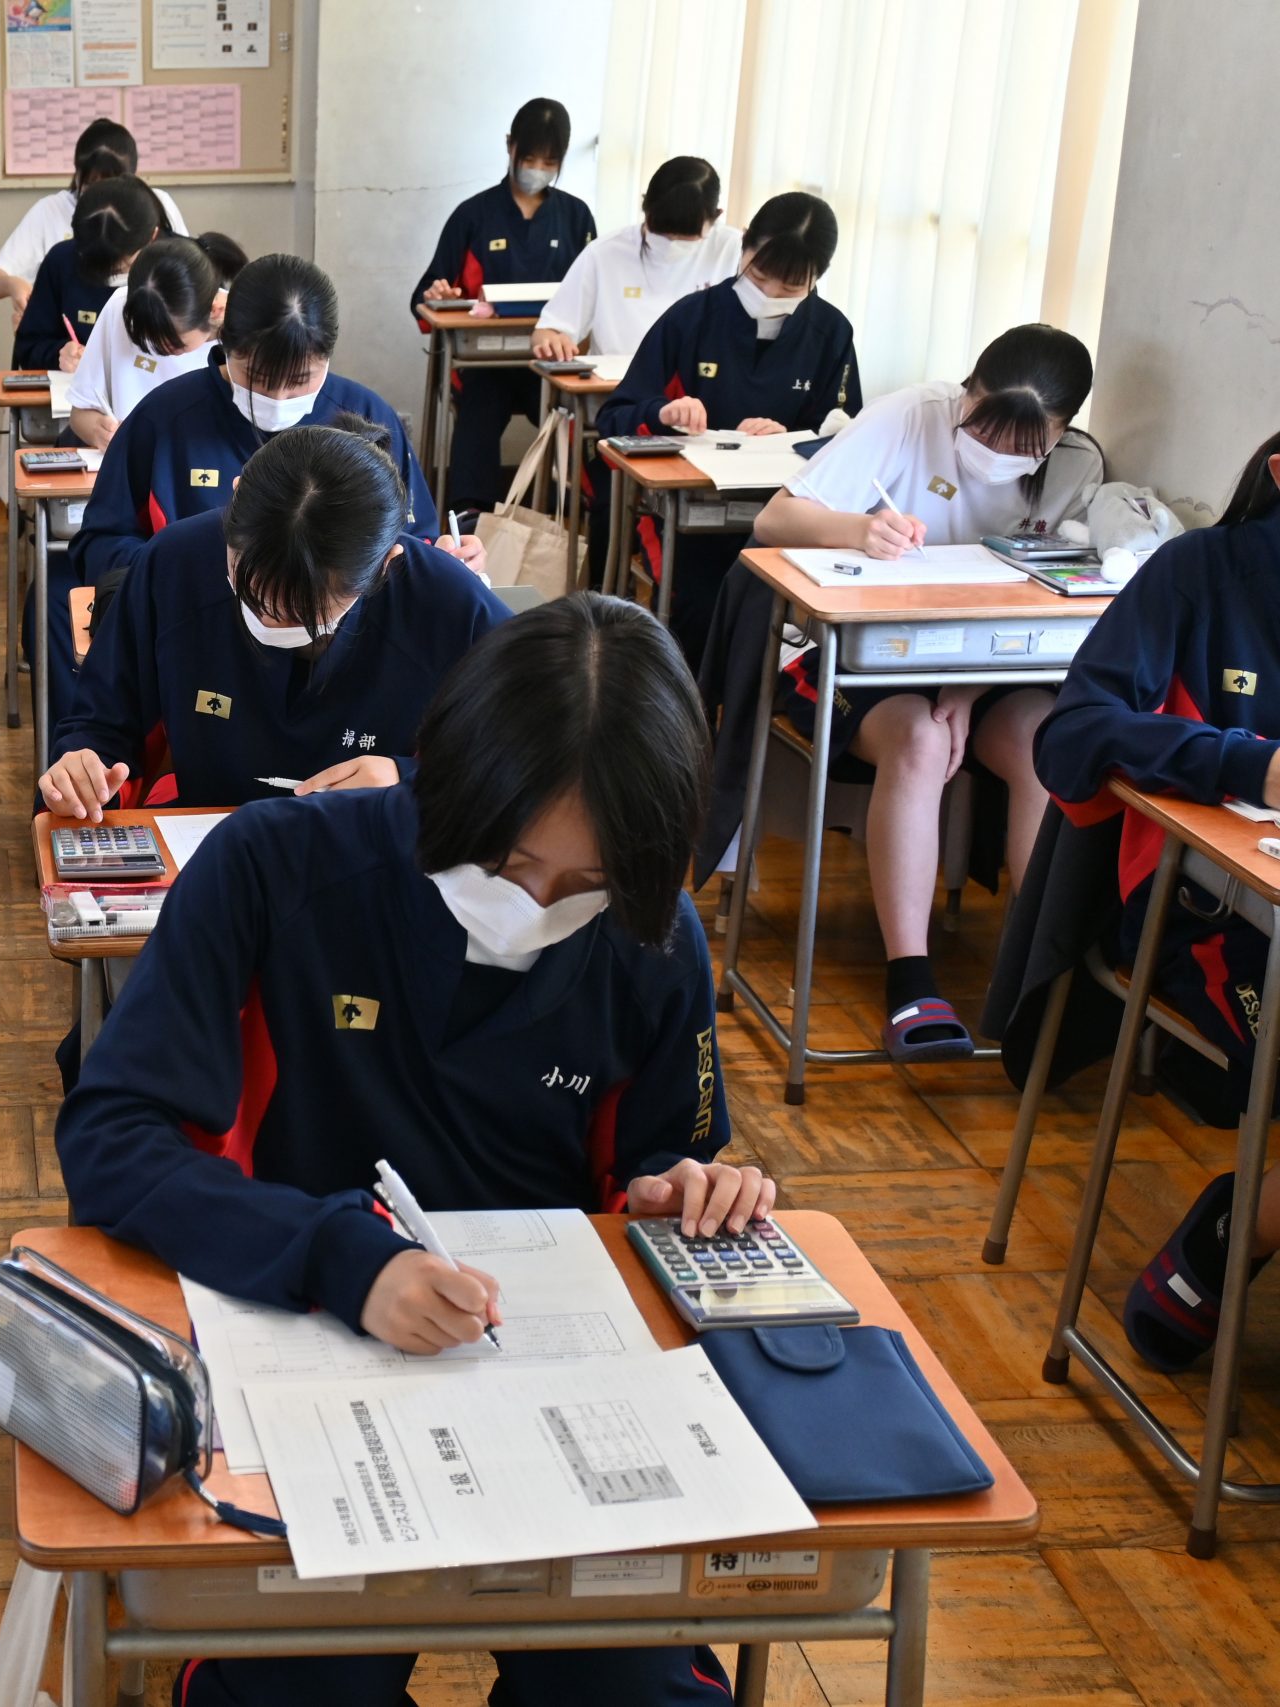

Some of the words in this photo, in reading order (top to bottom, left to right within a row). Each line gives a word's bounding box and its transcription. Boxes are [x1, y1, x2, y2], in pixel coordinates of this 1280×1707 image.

[342, 728, 376, 751] 掃部
[541, 1066, 591, 1096] 小川
[690, 1025, 713, 1146] DESCENTE
[349, 1400, 420, 1543] ビジネス計算実務検定模擬試験問題集
[449, 1471, 475, 1496] 2級
[332, 1497, 361, 1546] 令和5年度版
[711, 1552, 738, 1572] 特
